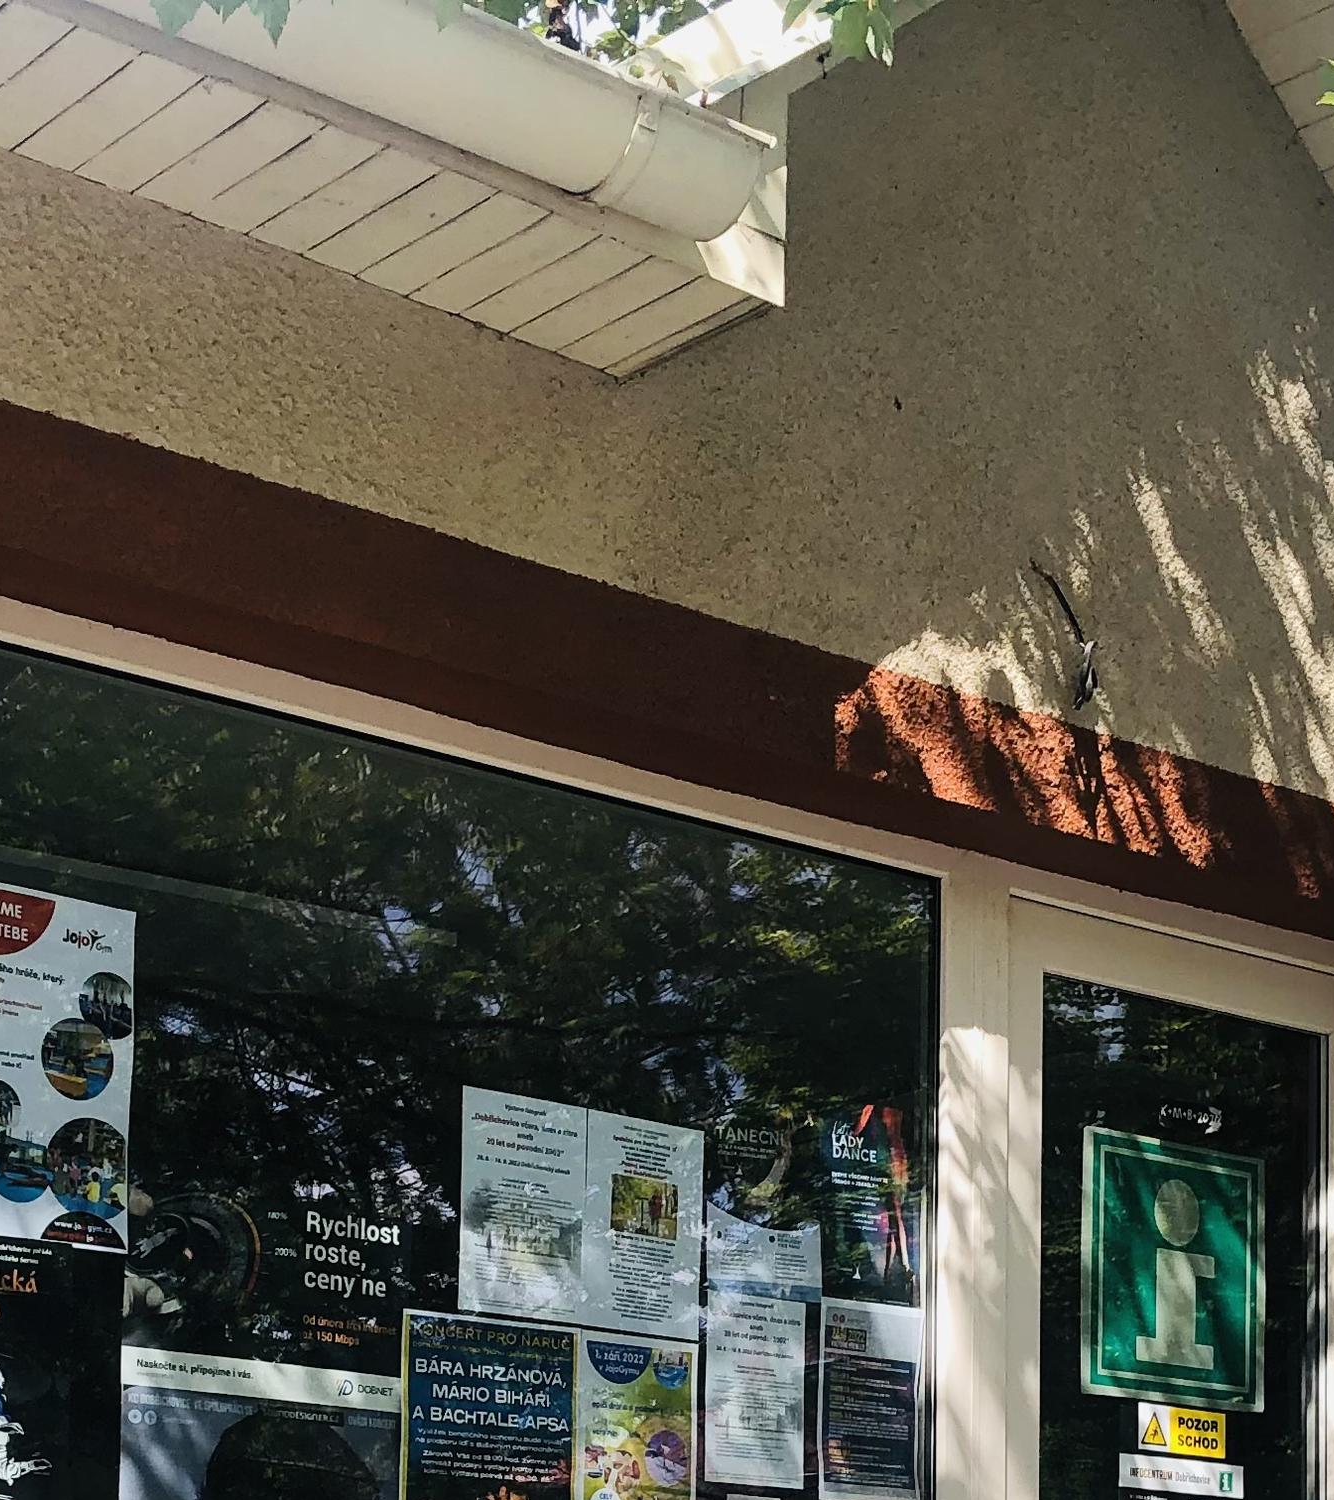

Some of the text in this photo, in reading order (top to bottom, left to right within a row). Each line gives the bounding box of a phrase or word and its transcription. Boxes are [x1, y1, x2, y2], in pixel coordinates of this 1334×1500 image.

[832, 1134, 864, 1149] LADY
[832, 1145, 877, 1163] DANCE
[306, 1210, 401, 1246] Rychlost
[305, 1243, 366, 1272] roste,
[304, 1271, 387, 1298] ceny ne
[302, 1314, 344, 1329] Od února
[316, 1331, 360, 1347] 150 Mbps
[410, 1321, 483, 1341] KONCERT
[487, 1330, 517, 1346] PRO
[603, 1349, 645, 1365] září 2022
[136, 1358, 237, 1377] Naskočte i
[415, 1354, 568, 1389] BÁRA HRZÁNOVÁ,
[605, 1364, 640, 1377] JojoGymu
[357, 1384, 394, 1397] DOBNET
[432, 1380, 490, 1402] MÁRIO
[412, 1405, 425, 1421] A
[430, 1406, 519, 1428] BACHTALE
[524, 1415, 570, 1433] APSA
[1177, 1416, 1219, 1433] POZOR
[1177, 1434, 1219, 1450] SCHOD
[1129, 1467, 1173, 1481] INFOCENTRUM
